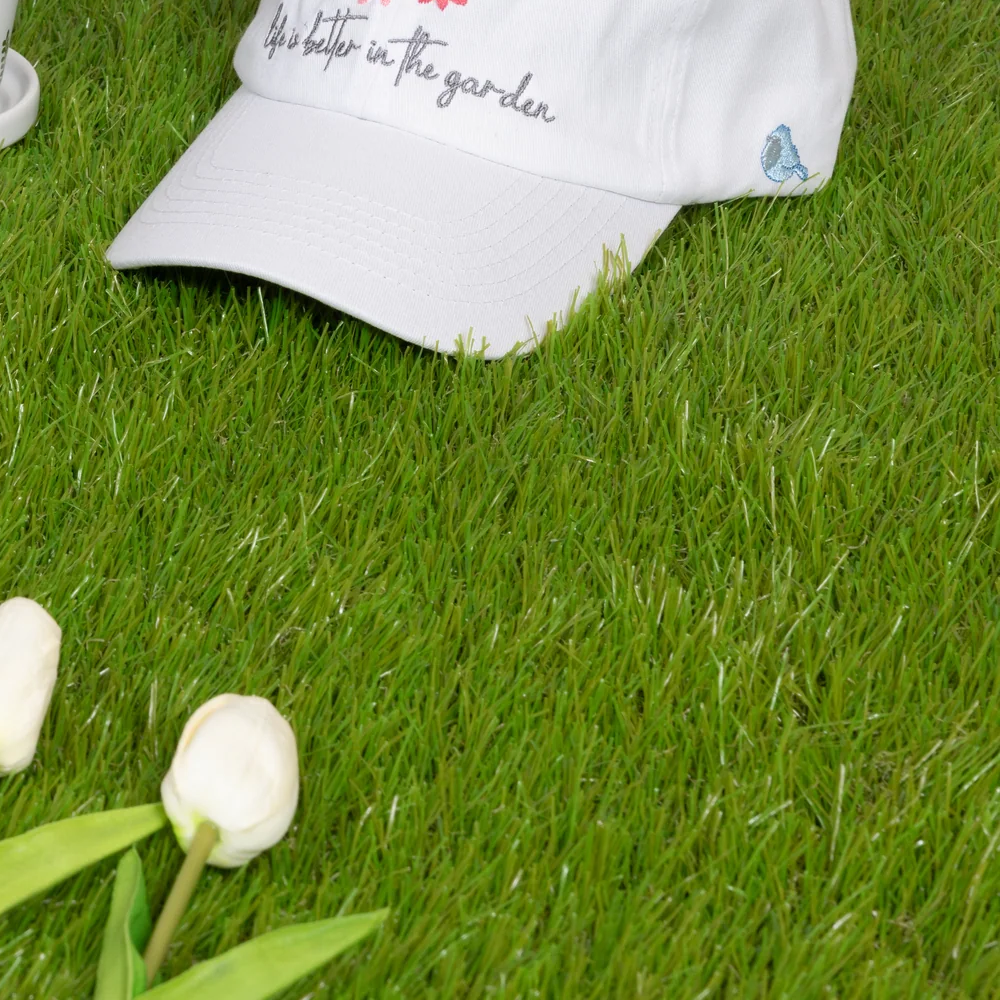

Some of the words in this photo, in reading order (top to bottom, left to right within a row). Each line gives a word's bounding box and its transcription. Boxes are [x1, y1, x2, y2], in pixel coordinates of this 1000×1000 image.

[263, 2, 288, 60] life
[286, 27, 300, 50] is
[302, 7, 369, 72] better
[366, 40, 396, 67] in
[387, 25, 449, 87] the
[436, 70, 556, 123] garden
